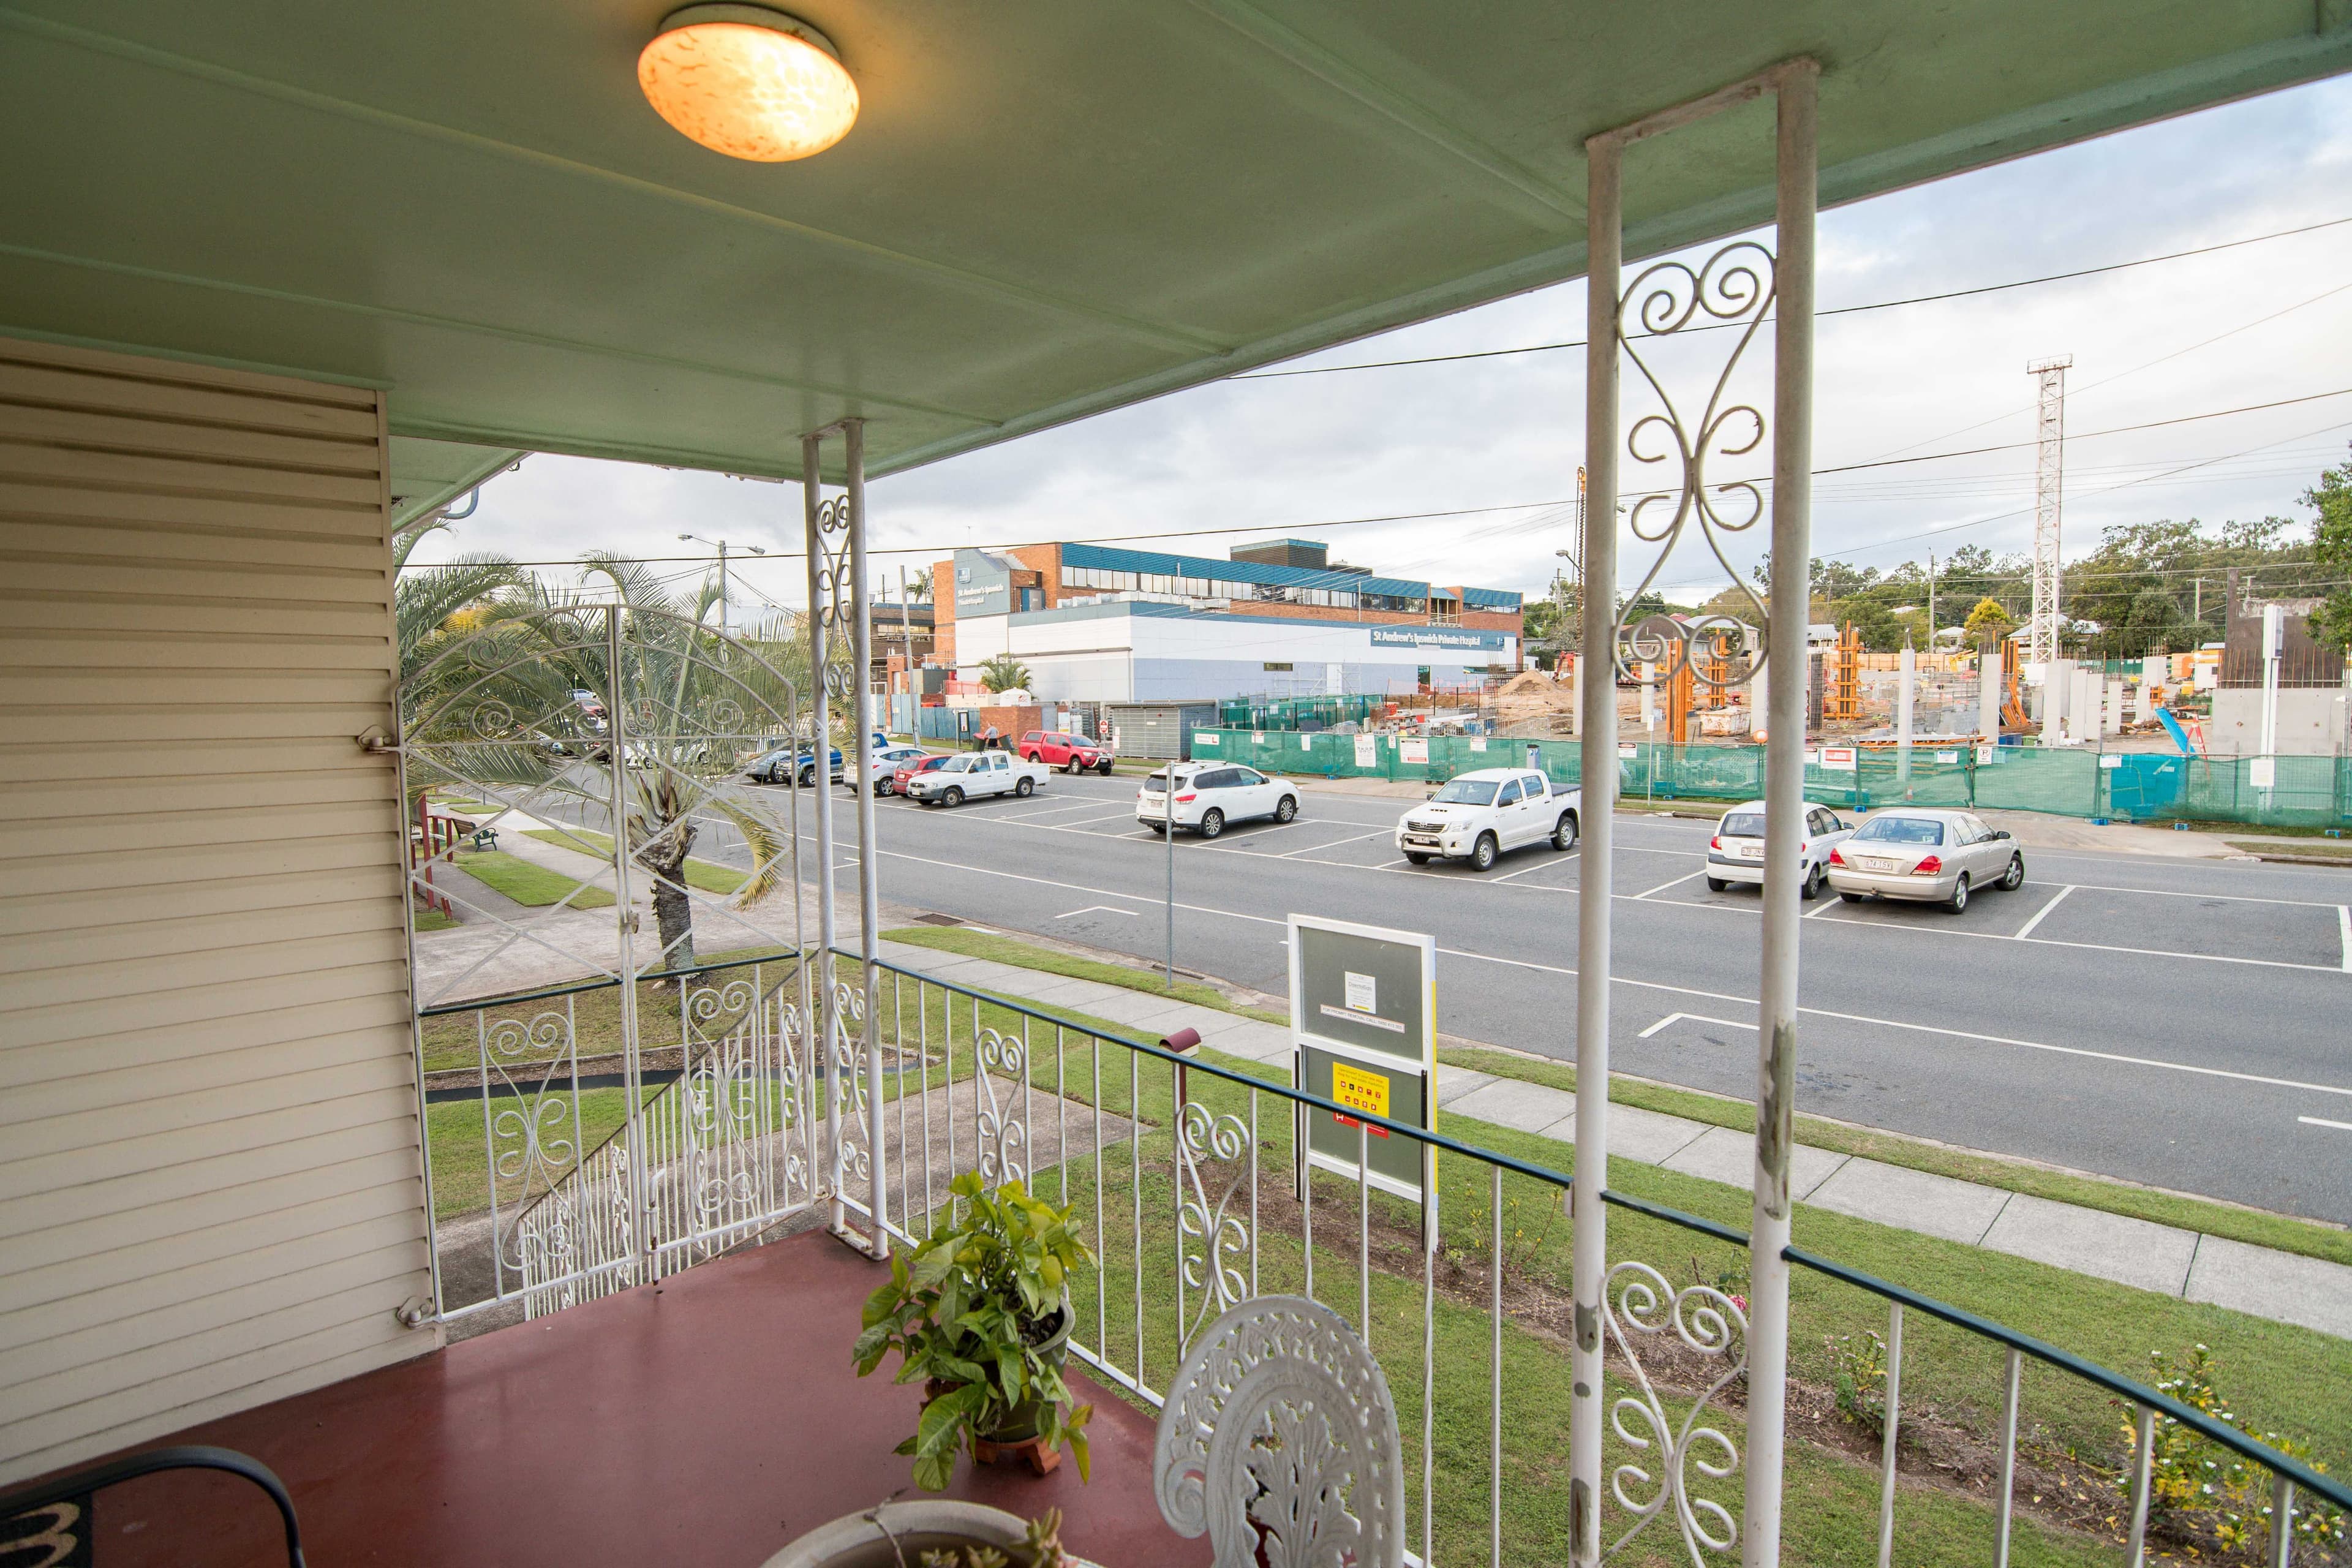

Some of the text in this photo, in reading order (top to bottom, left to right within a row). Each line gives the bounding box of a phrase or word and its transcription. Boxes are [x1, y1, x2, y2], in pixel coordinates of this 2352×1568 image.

[1373, 631, 1480, 647] St Andrew's Ipswich Private Hospital
